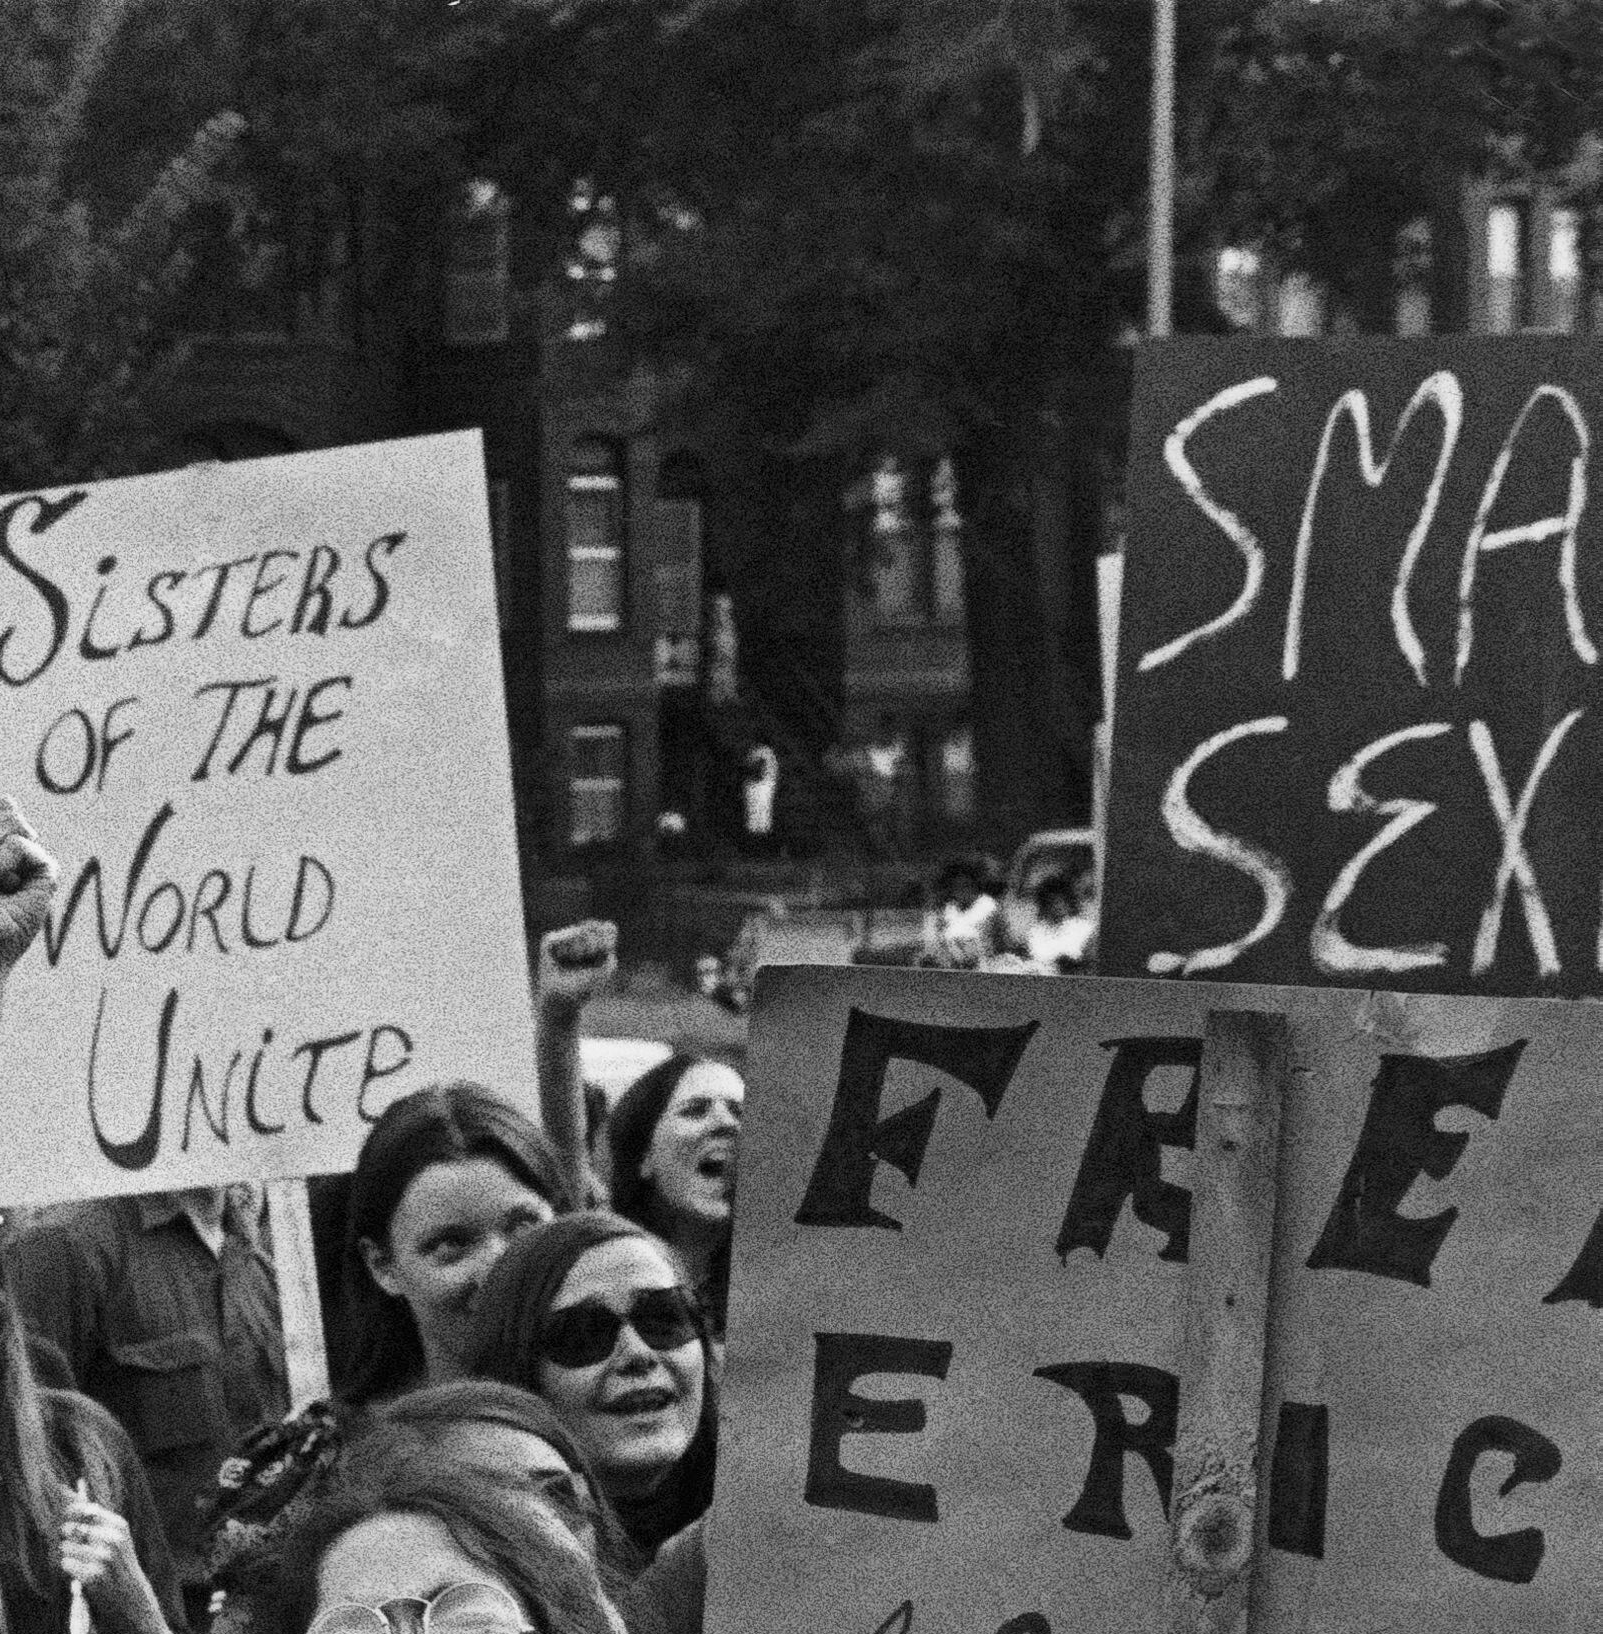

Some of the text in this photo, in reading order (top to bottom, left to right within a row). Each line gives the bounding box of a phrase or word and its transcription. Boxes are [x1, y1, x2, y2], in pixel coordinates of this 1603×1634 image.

[1138, 370, 1599, 687] SMA
[35, 675, 353, 795] OF THE
[1146, 708, 1603, 978] SEX
[44, 803, 336, 968] WORLD
[794, 1006, 1603, 1307] FRE
